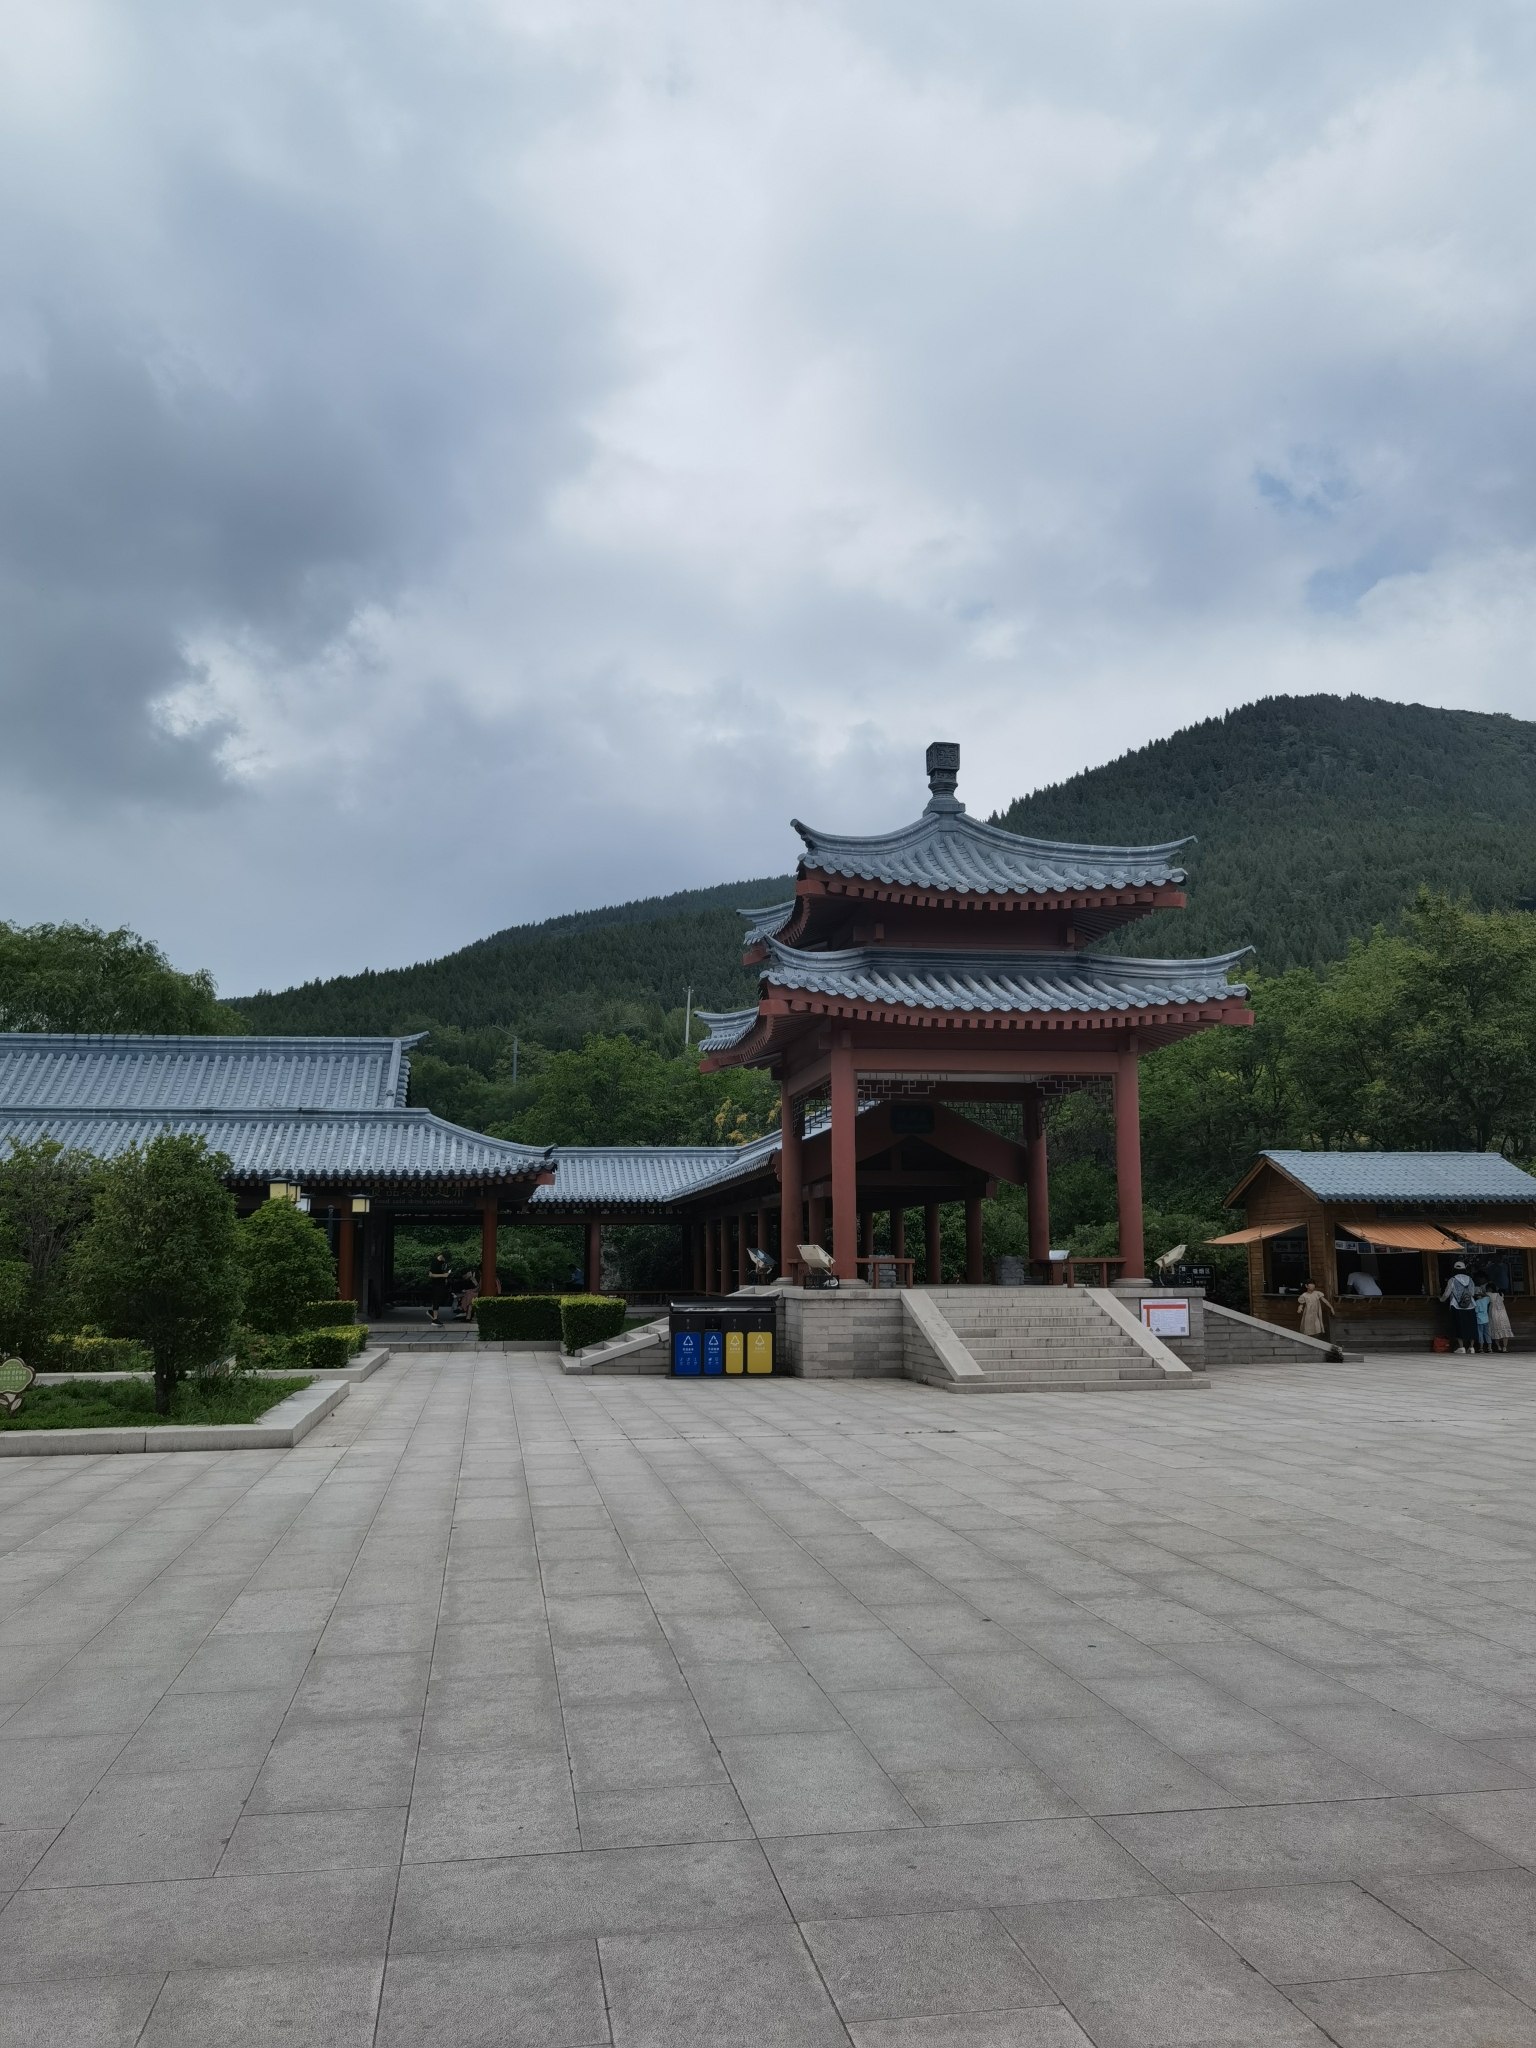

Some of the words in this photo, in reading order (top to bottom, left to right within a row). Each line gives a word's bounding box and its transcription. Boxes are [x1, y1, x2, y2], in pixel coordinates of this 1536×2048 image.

[368, 1185, 467, 1197] 食品冷饮超市
